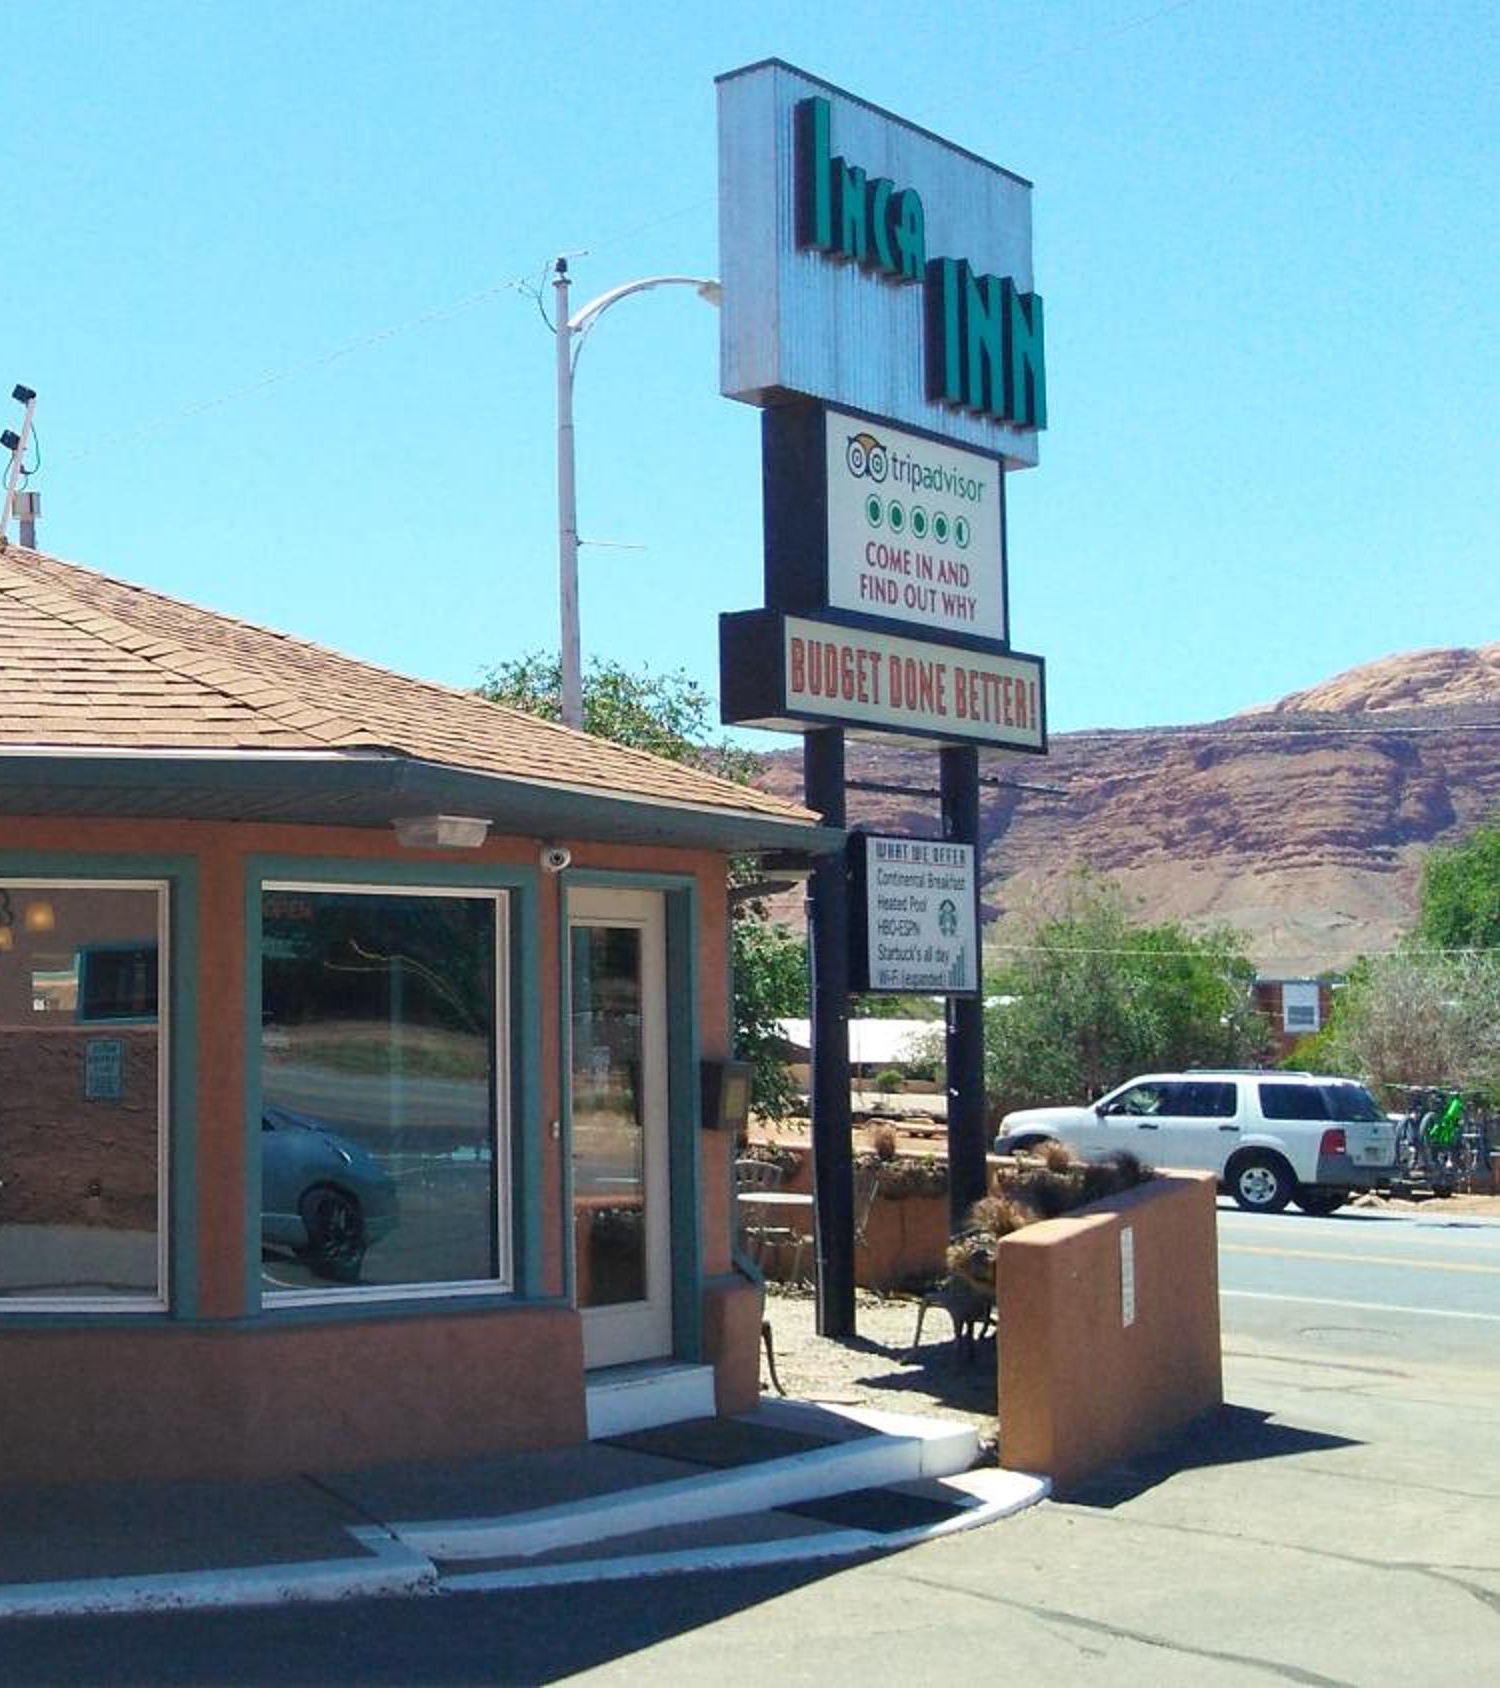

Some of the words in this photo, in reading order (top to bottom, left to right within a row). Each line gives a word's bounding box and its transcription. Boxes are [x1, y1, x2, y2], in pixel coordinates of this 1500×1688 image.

[925, 257, 1047, 430] INN
[891, 451, 986, 502] tripadvisor
[865, 540, 911, 576] COME
[915, 552, 933, 581] IN
[937, 559, 969, 588] AND
[859, 573, 899, 605] FIND
[903, 583, 937, 613] OUT
[941, 591, 977, 621] WHY
[790, 637, 883, 705] BUDGET
[888, 655, 947, 716] DONE
[954, 667, 1037, 731] BETTER!
[876, 842, 908, 859] WHAT
[911, 845, 928, 863] WE
[933, 847, 966, 865] OFFER
[877, 867, 925, 889] Continental
[927, 872, 966, 891] Breakfast
[877, 894, 908, 912] Heated
[909, 895, 929, 914] Pool
[923, 945, 933, 963] all
[935, 947, 950, 967] day
